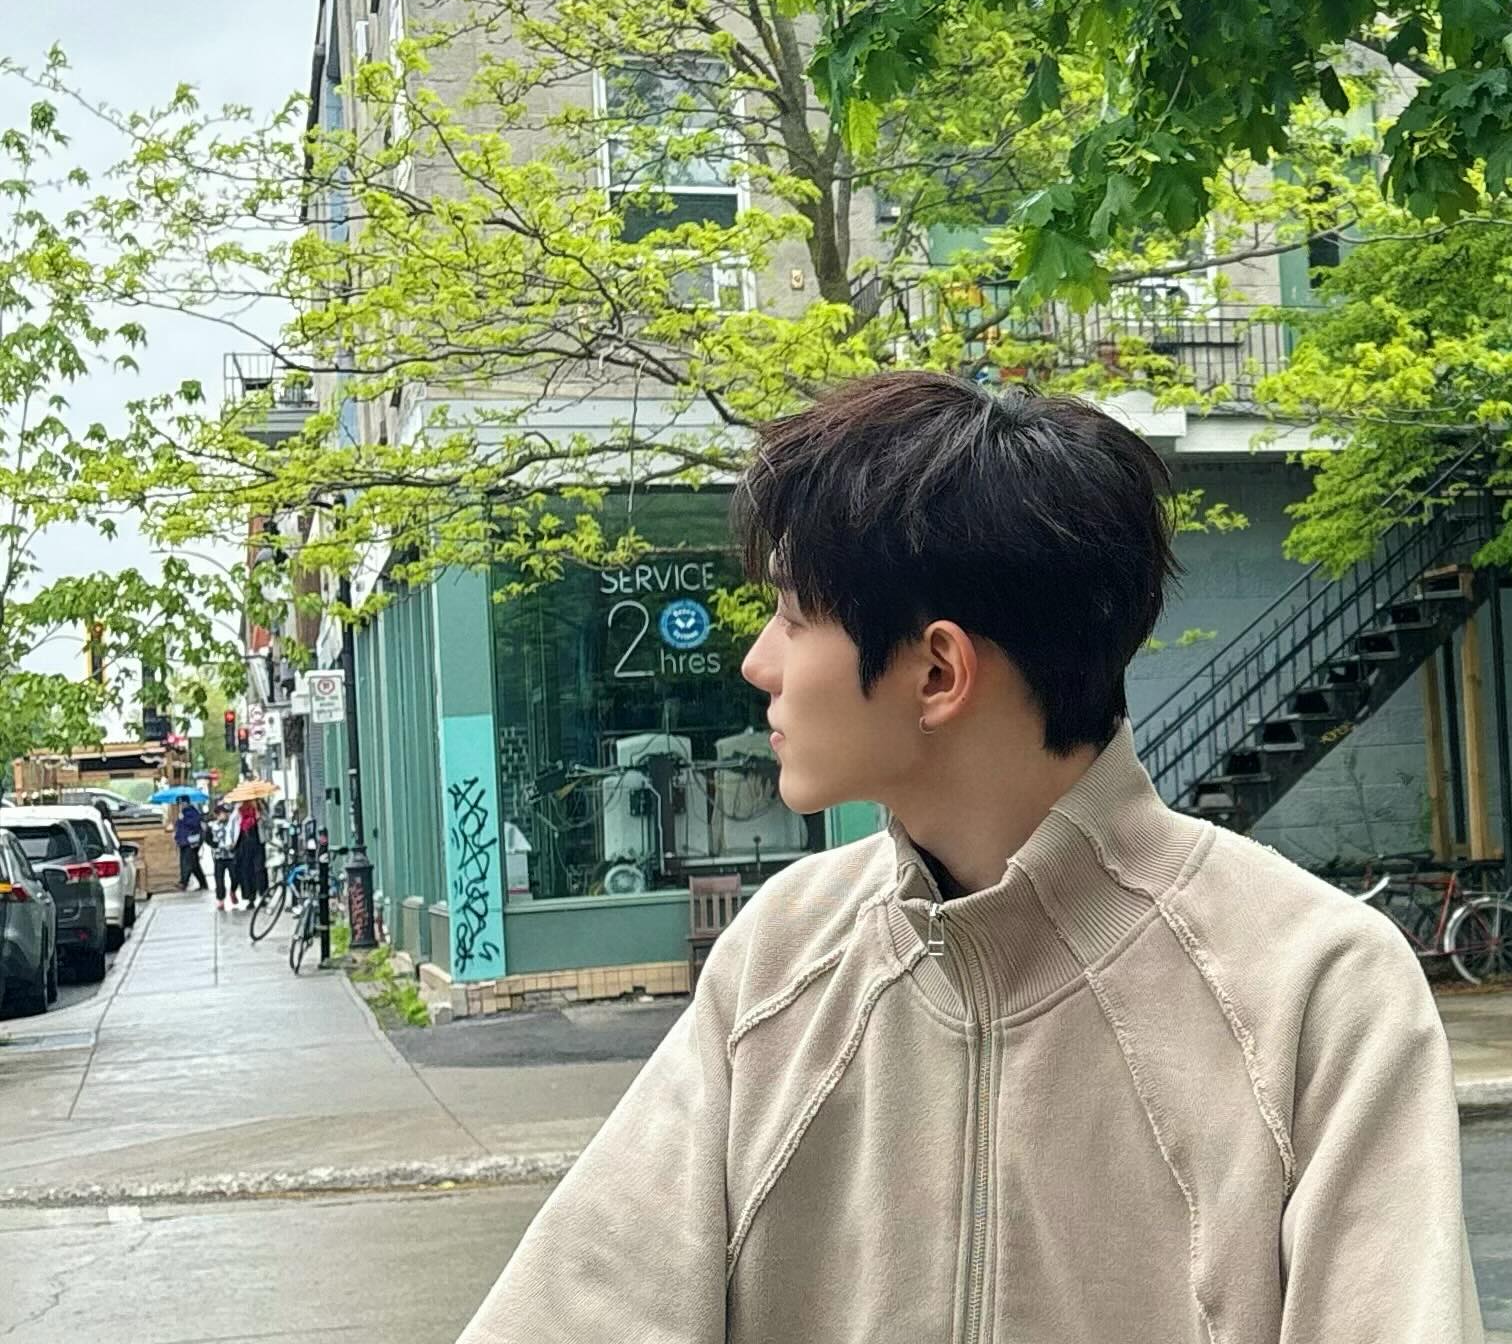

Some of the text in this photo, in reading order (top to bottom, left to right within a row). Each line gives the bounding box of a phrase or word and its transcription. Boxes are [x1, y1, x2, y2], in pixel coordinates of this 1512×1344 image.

[600, 562, 715, 594] SERVICE
[608, 600, 721, 677] 2 hres
